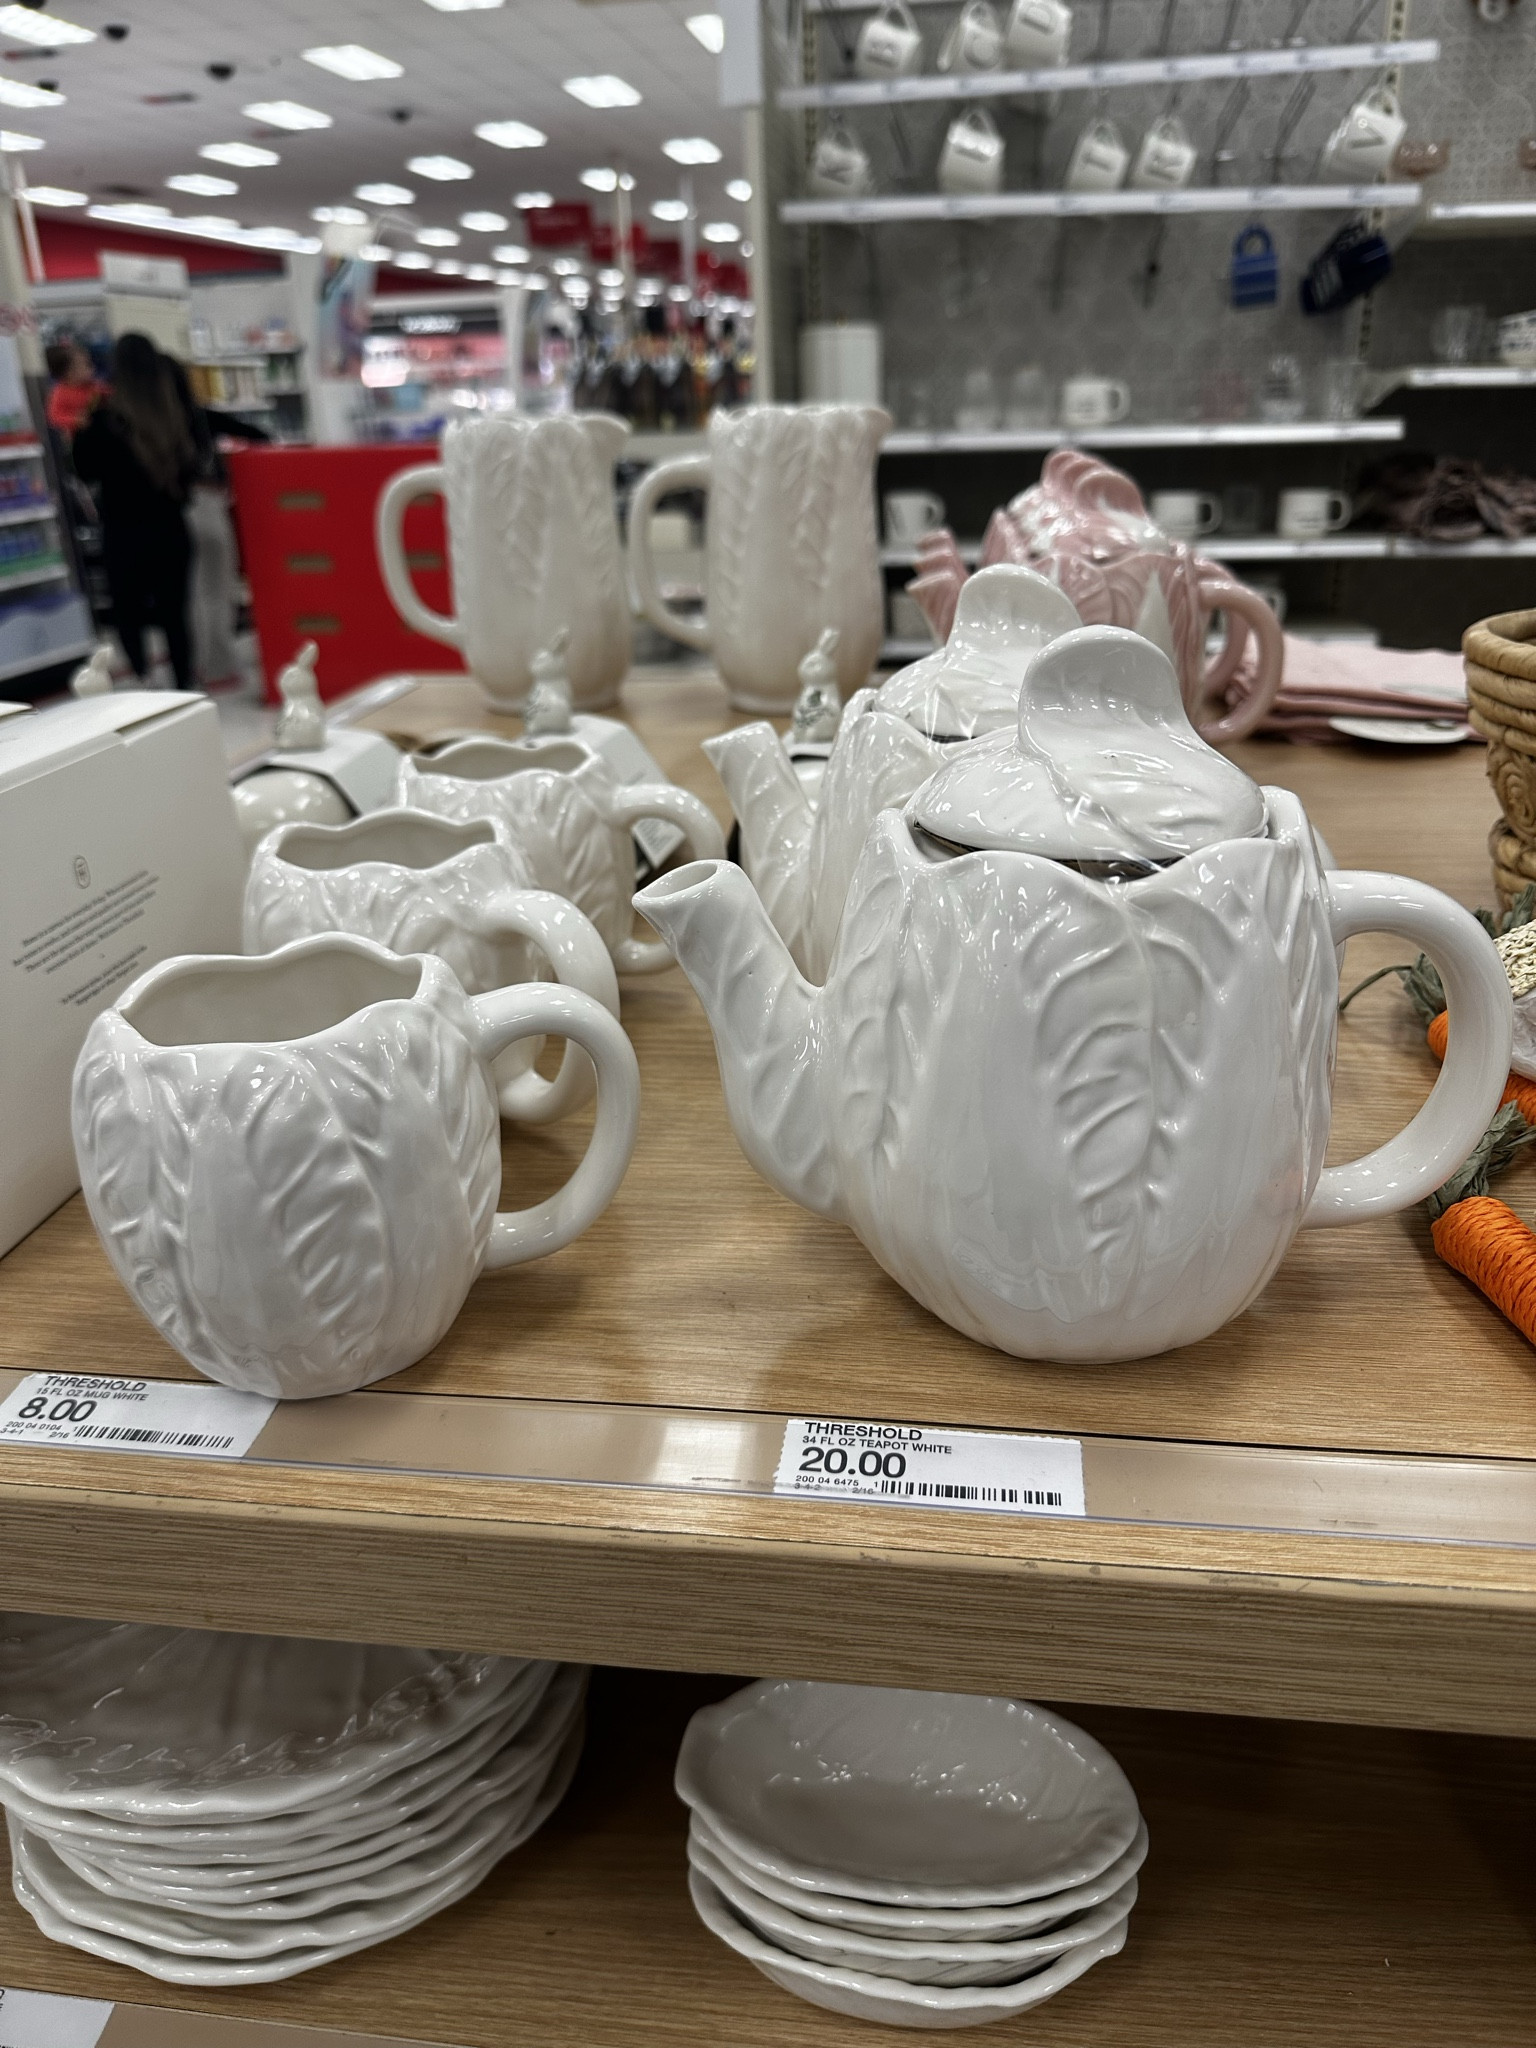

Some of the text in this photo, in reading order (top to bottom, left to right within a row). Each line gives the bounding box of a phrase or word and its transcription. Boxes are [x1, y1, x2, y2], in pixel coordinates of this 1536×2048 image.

[44, 1375, 147, 1392] THRESHOLD
[37, 1387, 150, 1401] 15 FL OZ MUG WHITE
[18, 1396, 98, 1422] 8.00
[6, 1421, 24, 1429] 200
[25, 1422, 38, 1430] 04
[804, 1421, 923, 1441] THRESHOLD
[48, 1431, 70, 1439] 2/16
[802, 1435, 952, 1454] 34 FL OZ TEAPOT WHITE
[798, 1446, 906, 1478] 20.00
[795, 1475, 815, 1483] 200
[818, 1476, 830, 1484] 04
[834, 1477, 859, 1487] 6475
[852, 1487, 874, 1495] 2/16
